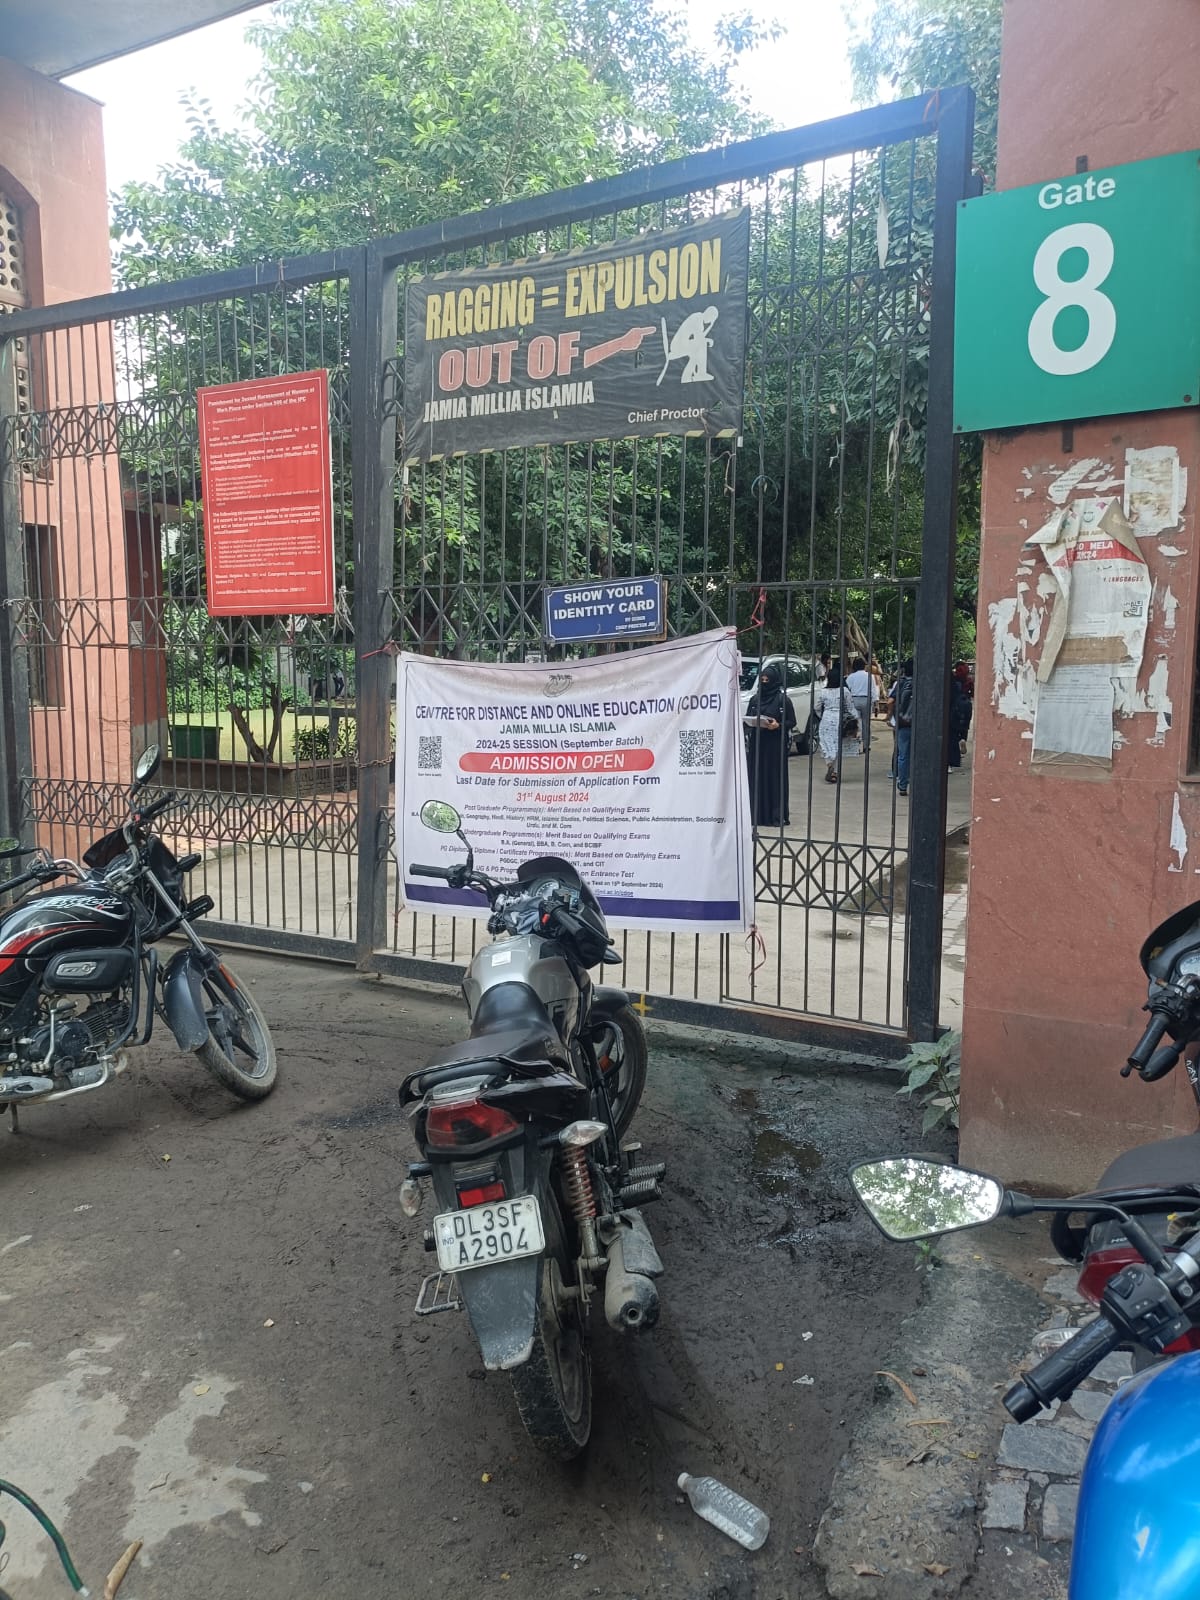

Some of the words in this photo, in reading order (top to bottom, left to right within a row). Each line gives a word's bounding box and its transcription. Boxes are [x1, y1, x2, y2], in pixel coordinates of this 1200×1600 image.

[1038, 175, 1116, 209] Gate
[425, 277, 535, 340] RAGGING
[565, 237, 721, 318] EXPULSION
[1027, 222, 1116, 375] 8
[439, 340, 518, 391] OUT
[527, 331, 581, 379] OF
[423, 399, 467, 423] JAMIA
[470, 390, 521, 418] MILLIA
[525, 380, 595, 410] ISLAMIA
[627, 408, 660, 424] Chief
[661, 405, 705, 421] Proctor
[564, 590, 602, 604] SHOW
[606, 585, 644, 599] YOUR
[554, 603, 615, 620] IDENTITY
[618, 599, 655, 613] CARD
[416, 705, 454, 720] CENTRE
[457, 706, 476, 720] FOR
[479, 705, 528, 720] DISTANCE
[531, 704, 554, 719] AND
[557, 702, 601, 719] ONLINE
[603, 697, 675, 717] EDUCATION
[678, 694, 722, 714] (CDOE)
[500, 724, 530, 734] JAMIA
[533, 723, 567, 734] MILLIA
[570, 721, 617, 733] ISLAMIA
[476, 740, 511, 749] 2024-25
[513, 739, 558, 749] SESSION
[561, 738, 614, 750] (September
[616, 736, 644, 746] Batch)
[490, 755, 578, 770] ADMISSION
[582, 754, 625, 769] OPEN
[456, 775, 473, 785] Last
[475, 776, 496, 786] Date
[498, 776, 511, 786] for
[513, 776, 565, 787] Submission
[567, 776, 577, 786] of
[578, 776, 630, 788] Application
[633, 775, 661, 786] Form
[535, 792, 567, 804] August
[569, 792, 589, 802] 2024
[454, 1203, 522, 1239] DL3SF
[442, 1237, 454, 1246] IND
[460, 1228, 528, 1265] A2904
